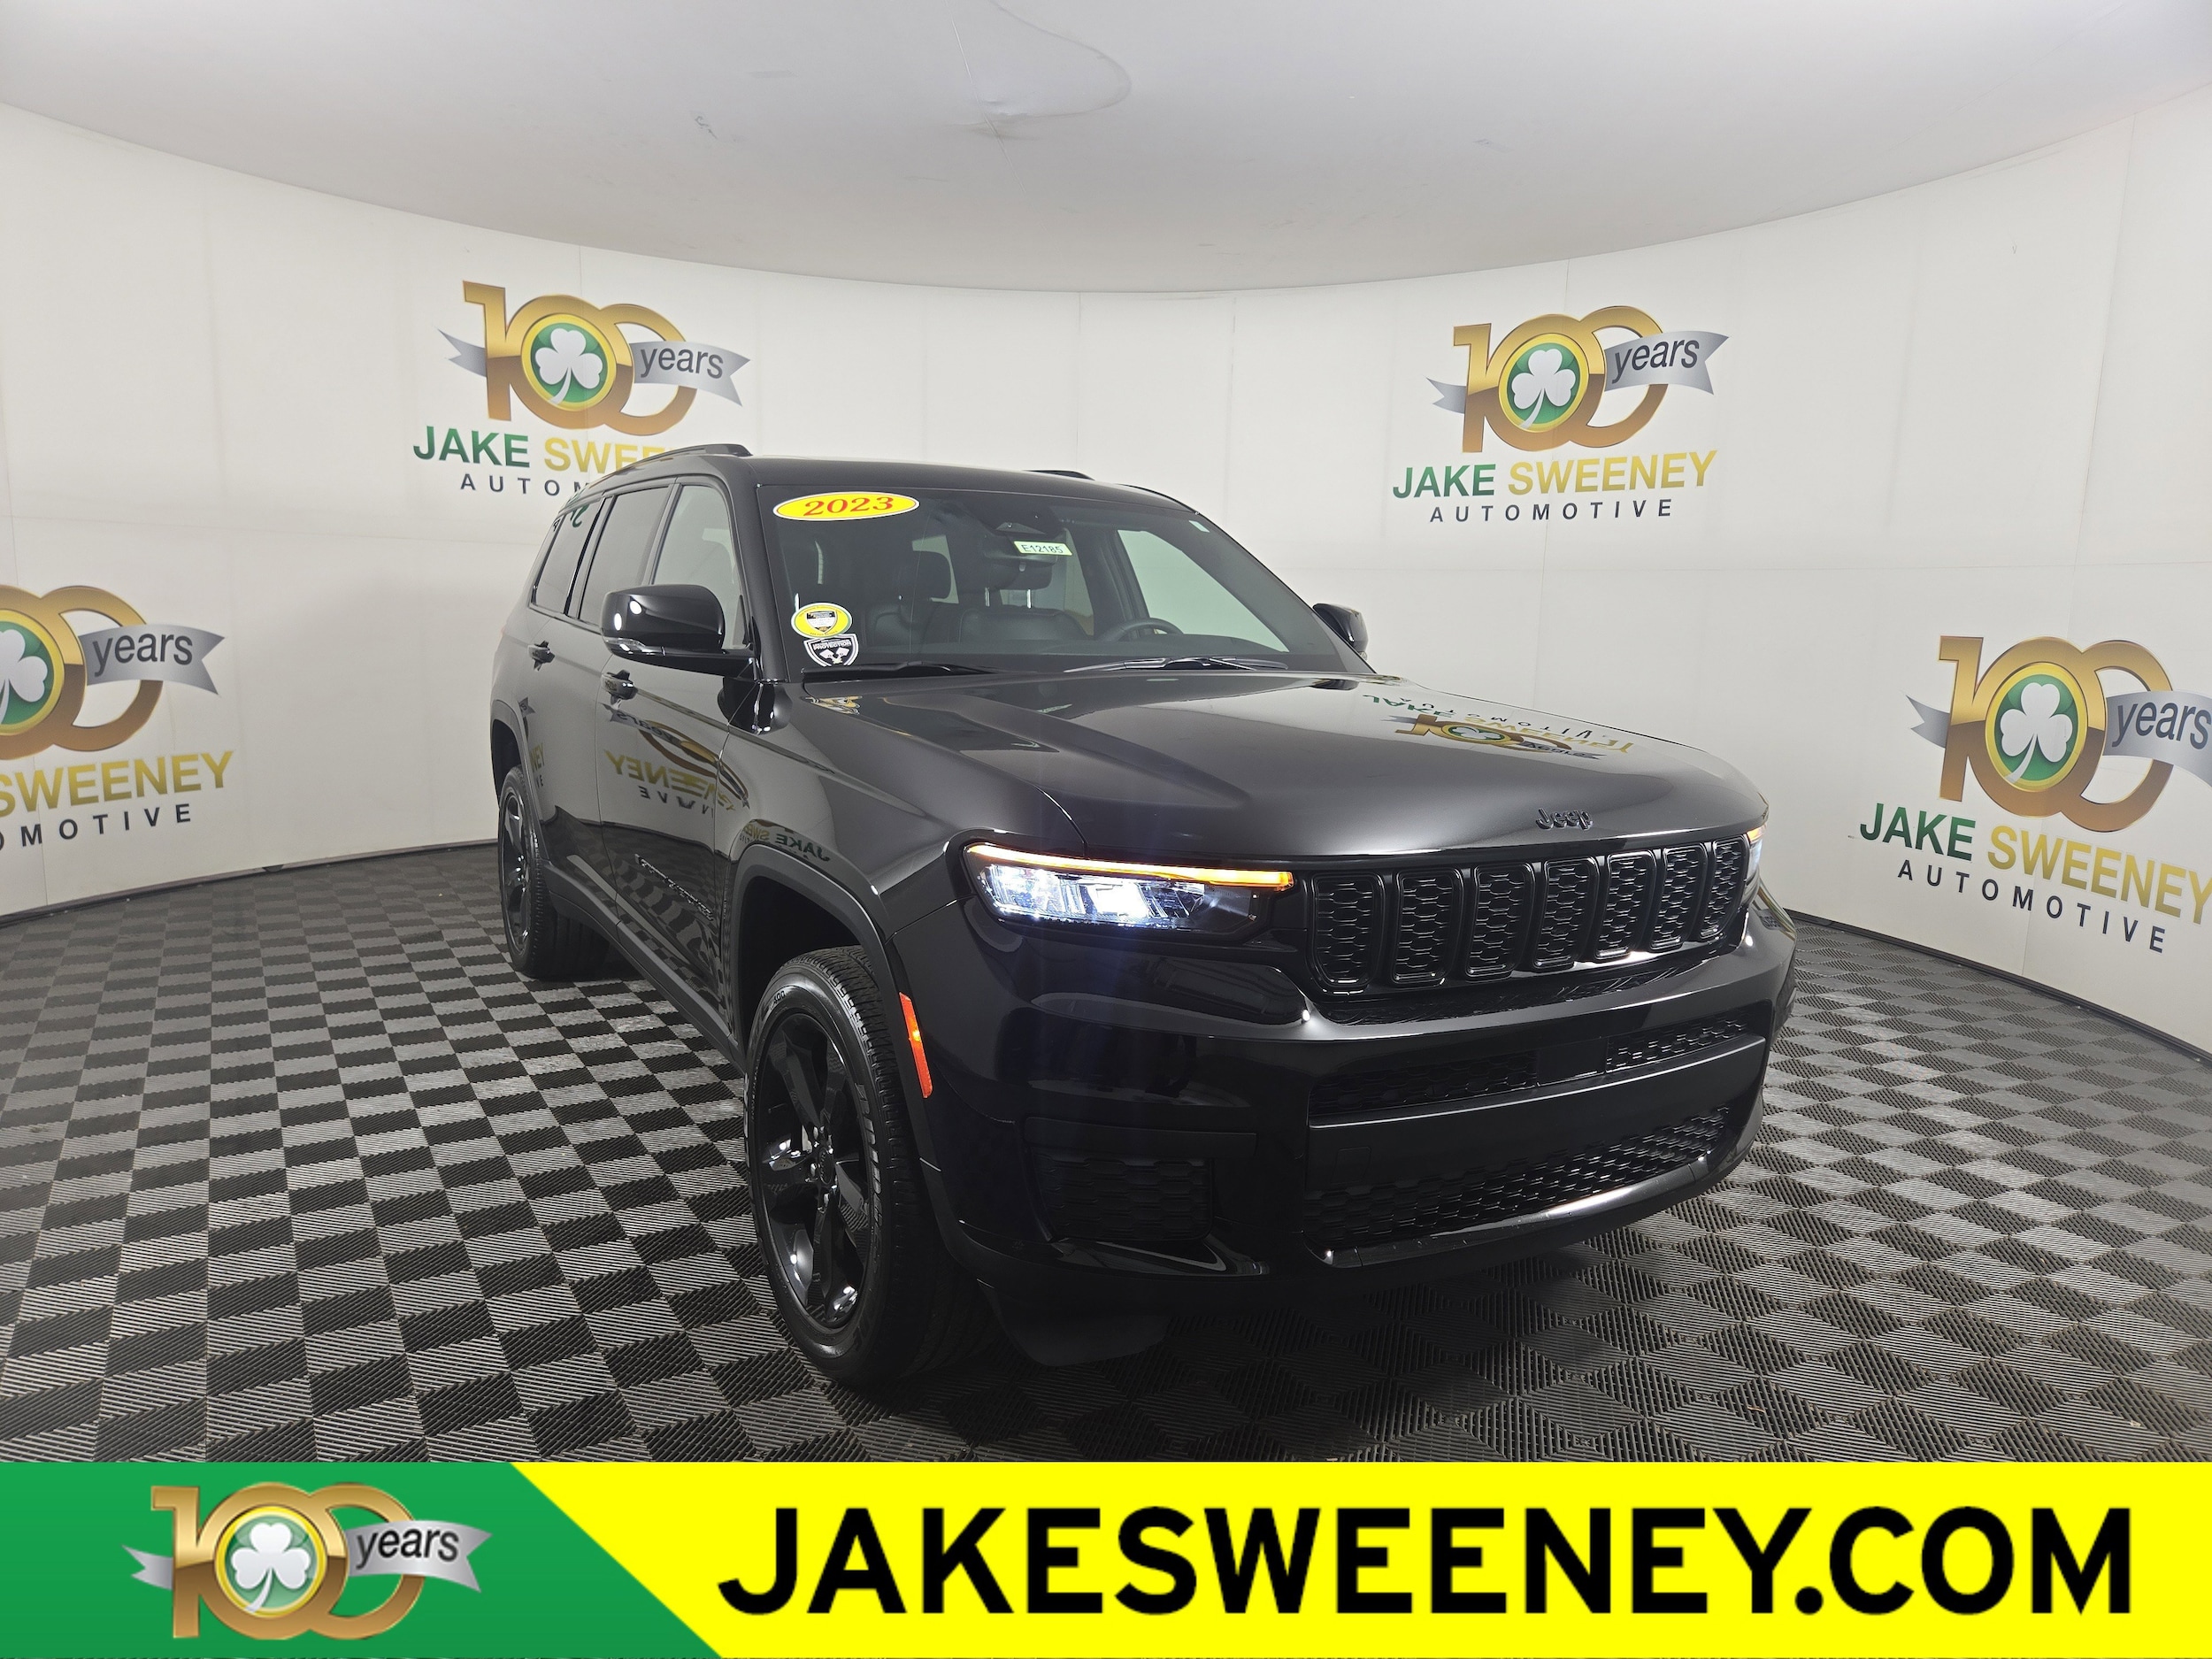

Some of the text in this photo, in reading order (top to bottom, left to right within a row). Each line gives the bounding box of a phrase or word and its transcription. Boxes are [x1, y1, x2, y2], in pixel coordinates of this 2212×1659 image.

[641, 348, 724, 379] years
[1611, 339, 1700, 384] years
[413, 426, 530, 467] JAKE
[1393, 449, 1717, 498] JAKE SWEENEY
[803, 496, 894, 517] 2023
[1430, 498, 1672, 523] AUTOMOTIVE
[92, 633, 193, 677] years
[2111, 702, 2212, 749] years
[1536, 808, 1593, 830] Jeep
[1860, 803, 2212, 926] JAKE SWEENEY
[1898, 859, 2166, 953] AUTOMOTIVE
